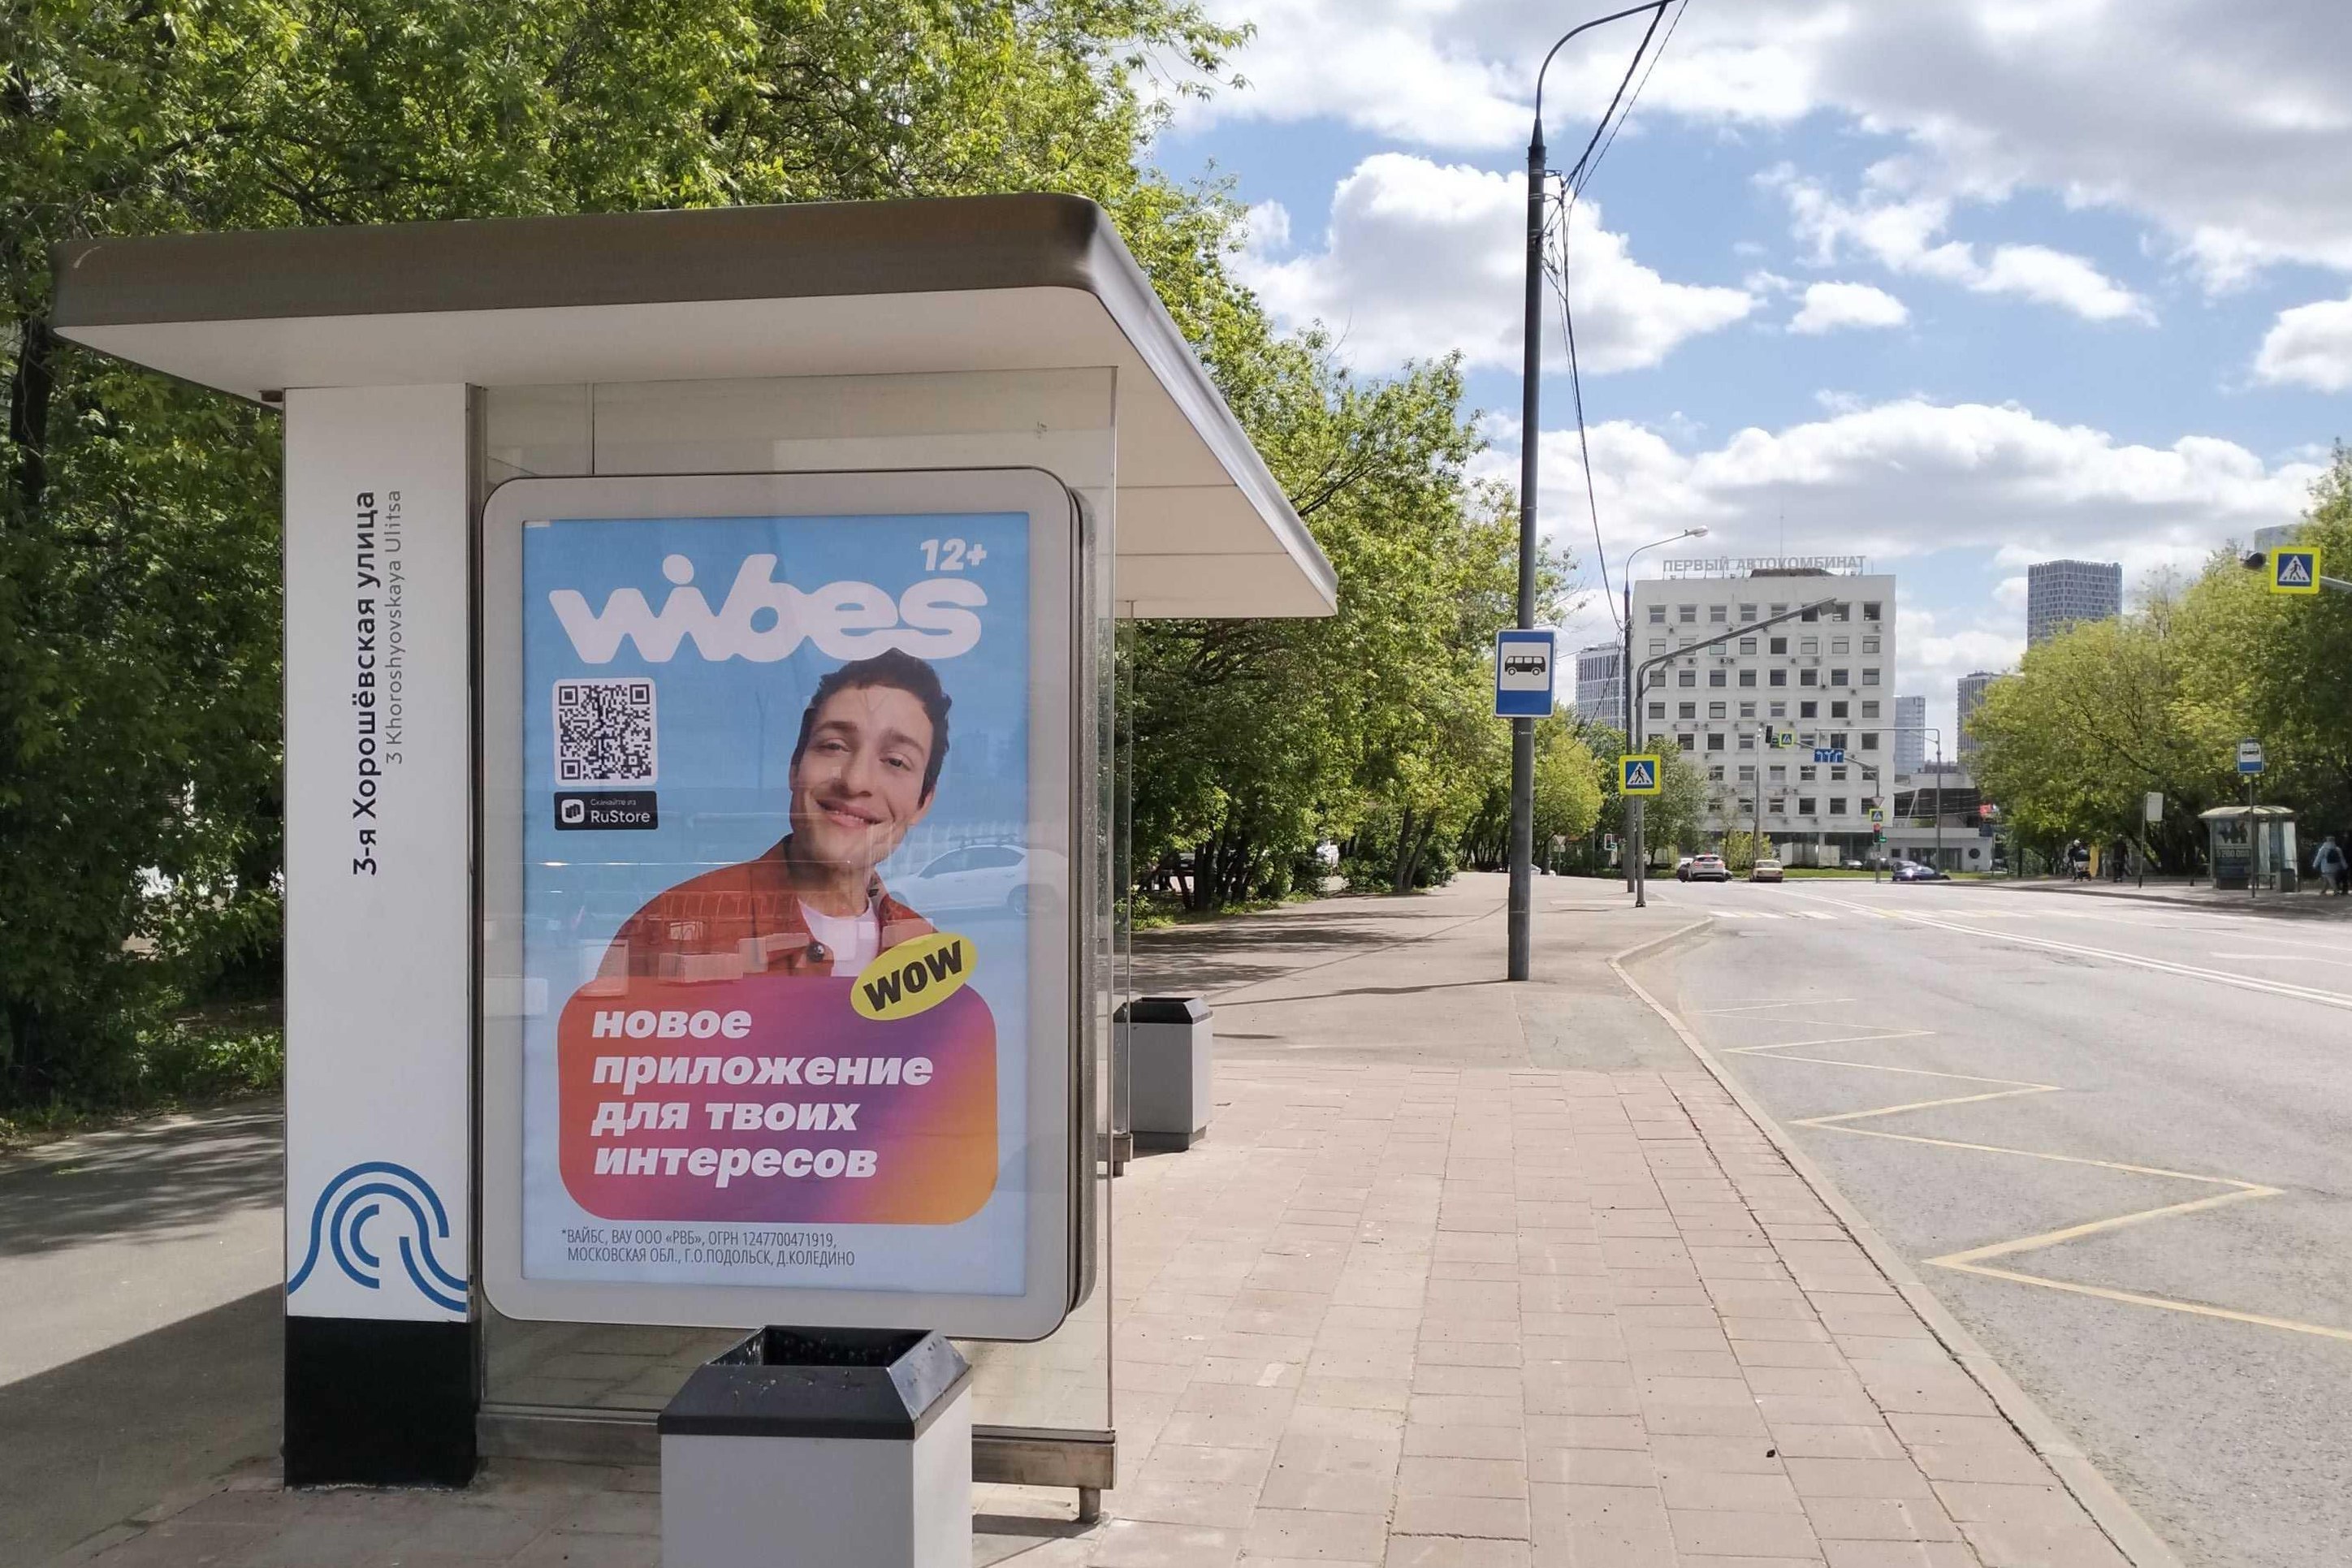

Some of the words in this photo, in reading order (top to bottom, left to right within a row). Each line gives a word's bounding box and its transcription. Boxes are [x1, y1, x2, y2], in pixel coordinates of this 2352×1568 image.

[355, 491, 381, 589] улица
[384, 490, 402, 553] Ulitsa
[919, 538, 988, 572] 12+
[1662, 556, 1730, 572] ПЕРВЫЙ
[1736, 555, 1866, 570] АВТОКОМБИНАТ
[548, 553, 988, 663] wibes
[384, 560, 406, 745] Khoroshyovskaya
[352, 598, 382, 819] Хорошёвская
[386, 752, 403, 765] 3
[590, 810, 651, 823] RuStore
[352, 828, 377, 875] 3-я
[863, 940, 963, 1012] WOW
[592, 1009, 752, 1039] новое
[592, 1056, 933, 1095] приложение
[590, 1102, 689, 1137] для
[705, 1102, 860, 1131] твоих
[594, 1147, 878, 1188] интересов
[568, 1246, 646, 1263] МОСКОВСКАЯ
[650, 1248, 681, 1263] ОБЛ.,
[776, 1251, 855, 1268] Д.КОЛЕДИНО
[612, 1229, 632, 1244] ВАУ
[635, 1229, 662, 1244] ООО
[665, 1230, 705, 1246] «РВБ»,
[708, 1231, 738, 1246] ОГРН
[743, 1232, 837, 1249] 1247700471919,
